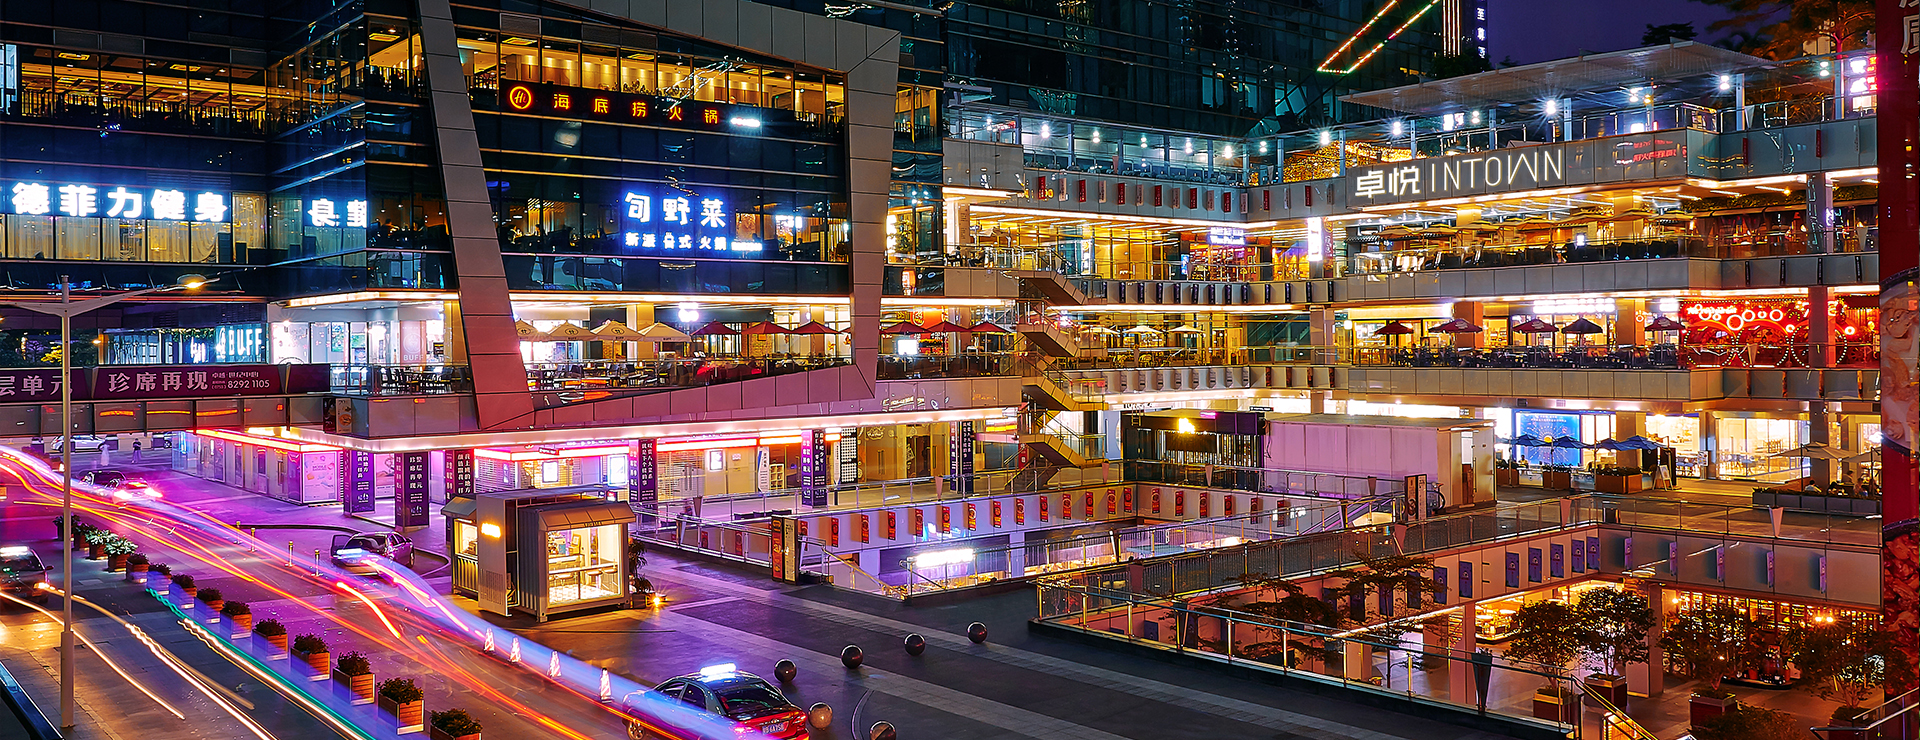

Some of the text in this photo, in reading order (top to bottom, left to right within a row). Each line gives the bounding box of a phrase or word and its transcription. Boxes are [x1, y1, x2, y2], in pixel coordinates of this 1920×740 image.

[553, 94, 718, 125] 海底捞火锅
[1355, 148, 1563, 198] 卓悦 INTOWN
[12, 182, 228, 222] 德菲力健身
[624, 192, 726, 228] 旬野菜
[228, 327, 263, 356] BUFF
[108, 371, 208, 392] 珍席再现
[227, 380, 249, 389] 8292
[252, 379, 270, 388] 1105
